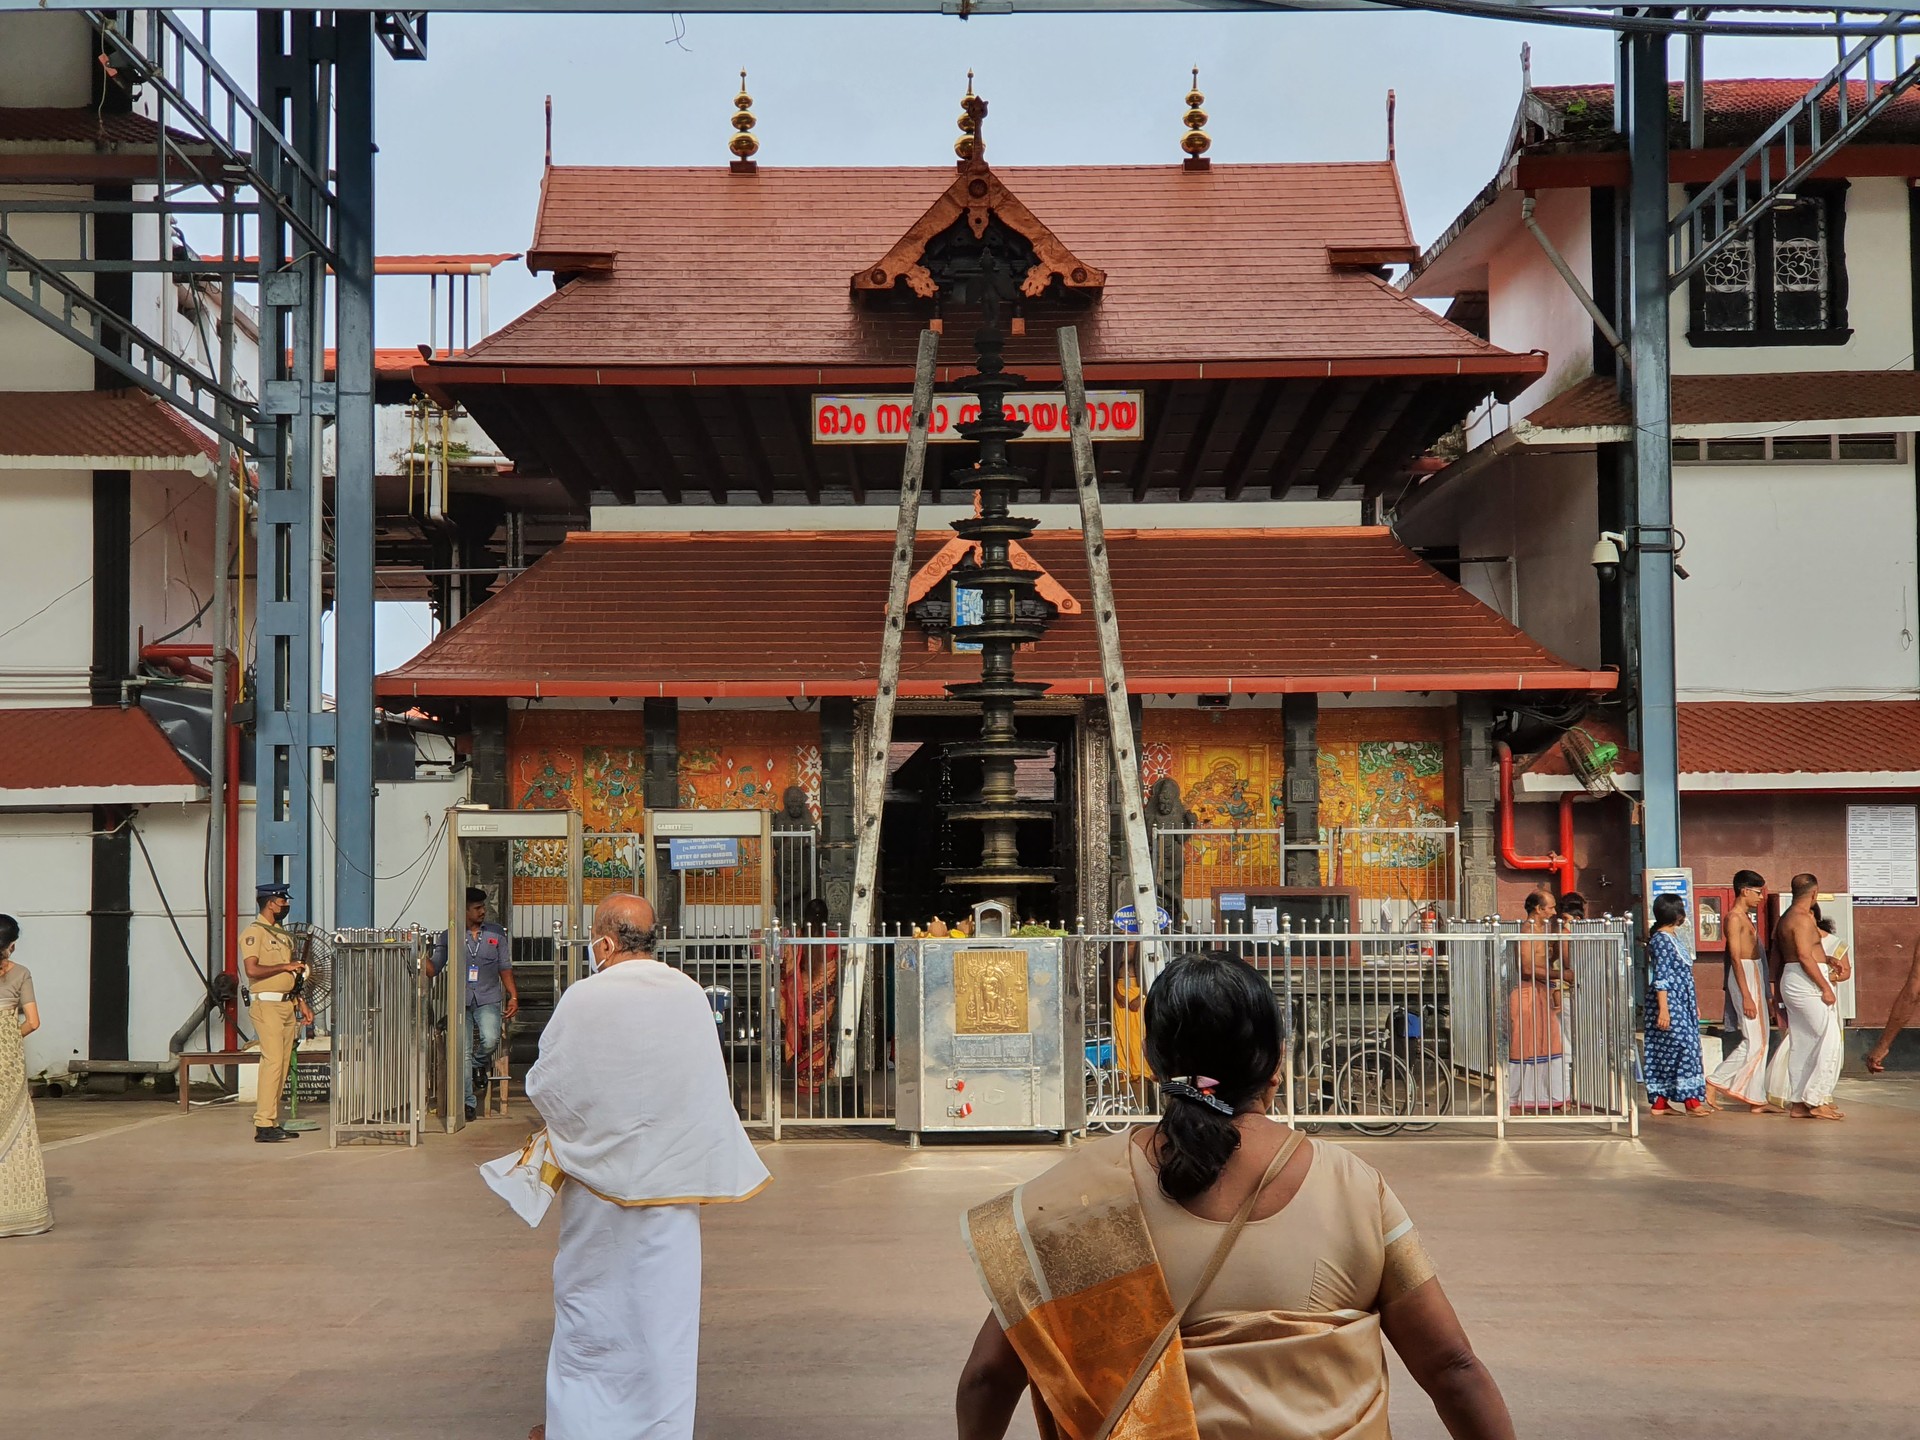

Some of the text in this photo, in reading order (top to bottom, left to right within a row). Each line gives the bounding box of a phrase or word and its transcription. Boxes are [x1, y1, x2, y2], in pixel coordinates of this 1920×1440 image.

[818, 404, 866, 434] ഓം
[877, 403, 948, 434] നോ
[1699, 913, 1721, 924] FIRE
